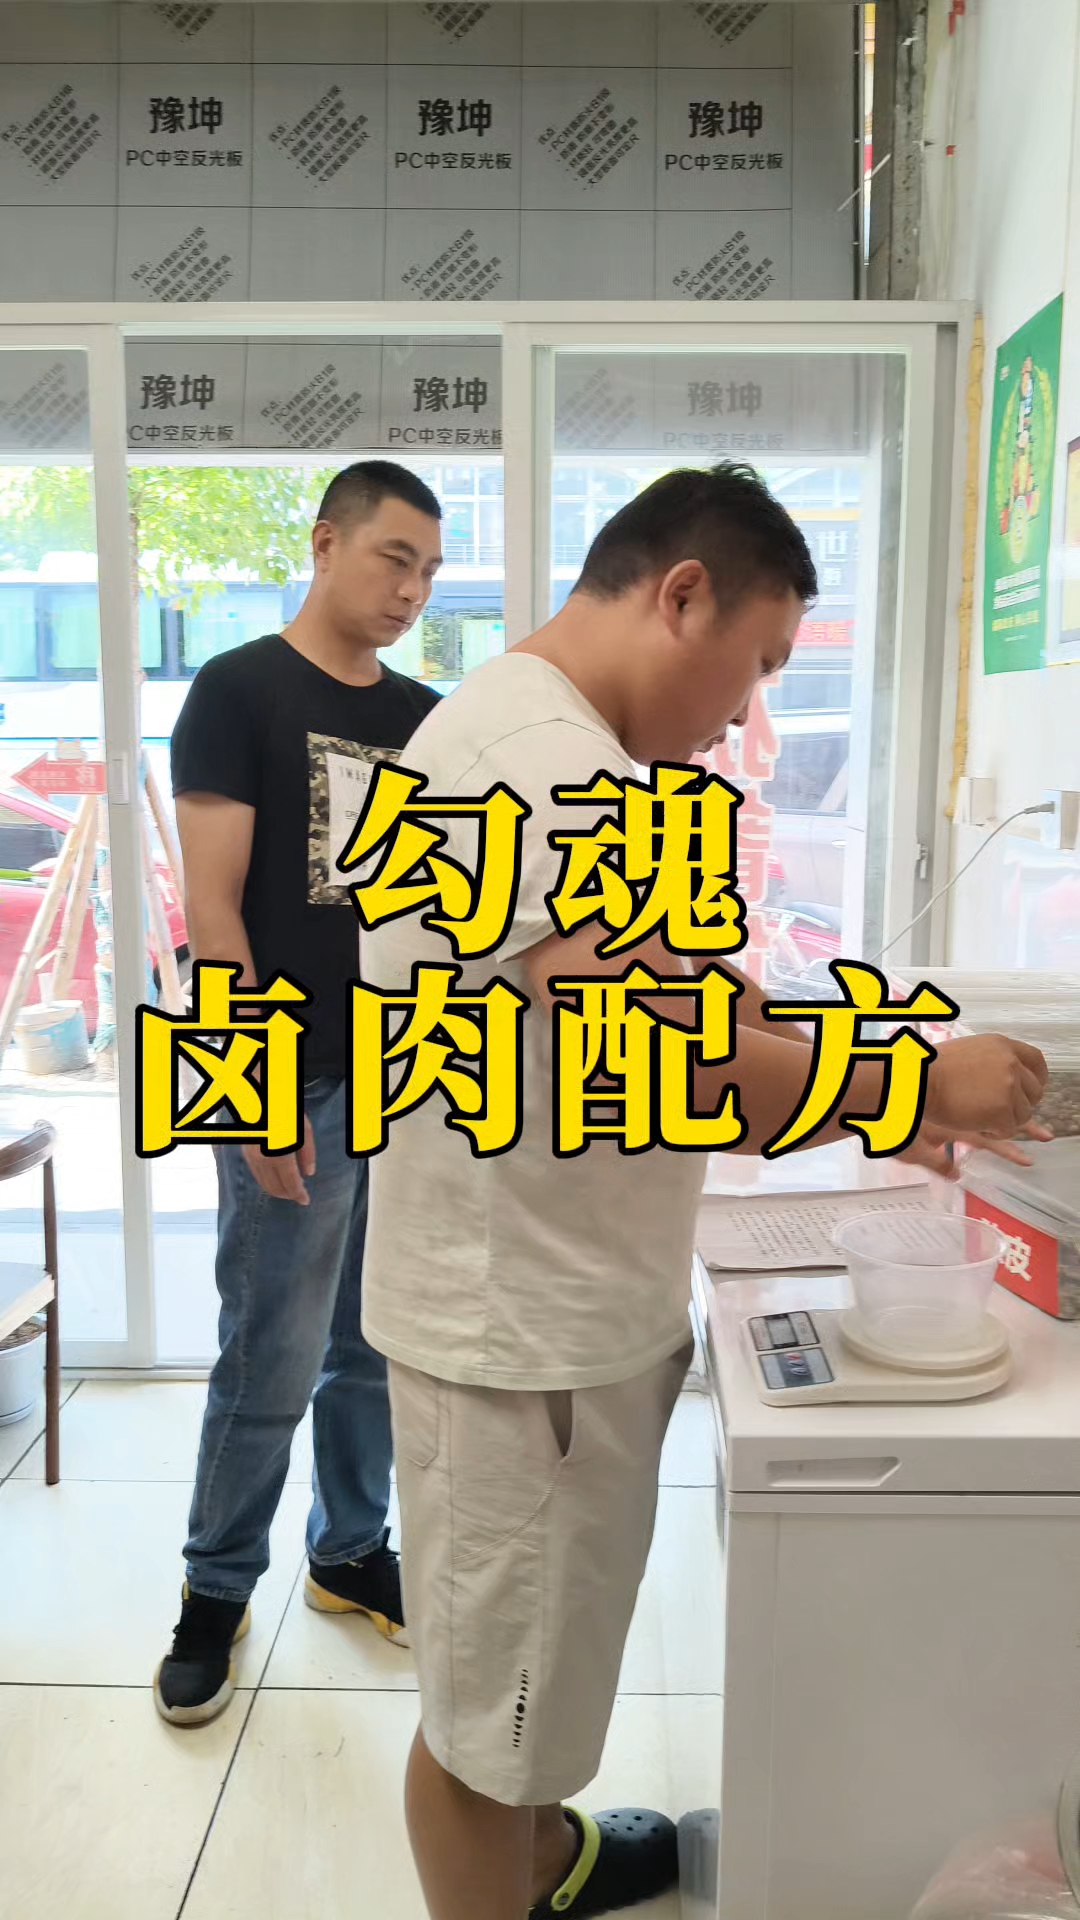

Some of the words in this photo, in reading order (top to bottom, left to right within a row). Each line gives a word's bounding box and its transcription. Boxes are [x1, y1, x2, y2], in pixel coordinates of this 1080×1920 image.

[149, 97, 222, 134] 豫坤
[419, 98, 491, 137] 豫坤
[689, 101, 762, 138] 豫坤
[127, 150, 242, 166] PC中空反光板
[395, 152, 511, 169] PC中空反光板
[665, 153, 783, 170] PC中空反光板
[141, 374, 214, 410] 豫坤
[414, 377, 486, 413] 豫坤
[687, 380, 763, 418] 豫坤
[130, 425, 232, 440] C中空反光板
[663, 432, 783, 449] PC中空反光板
